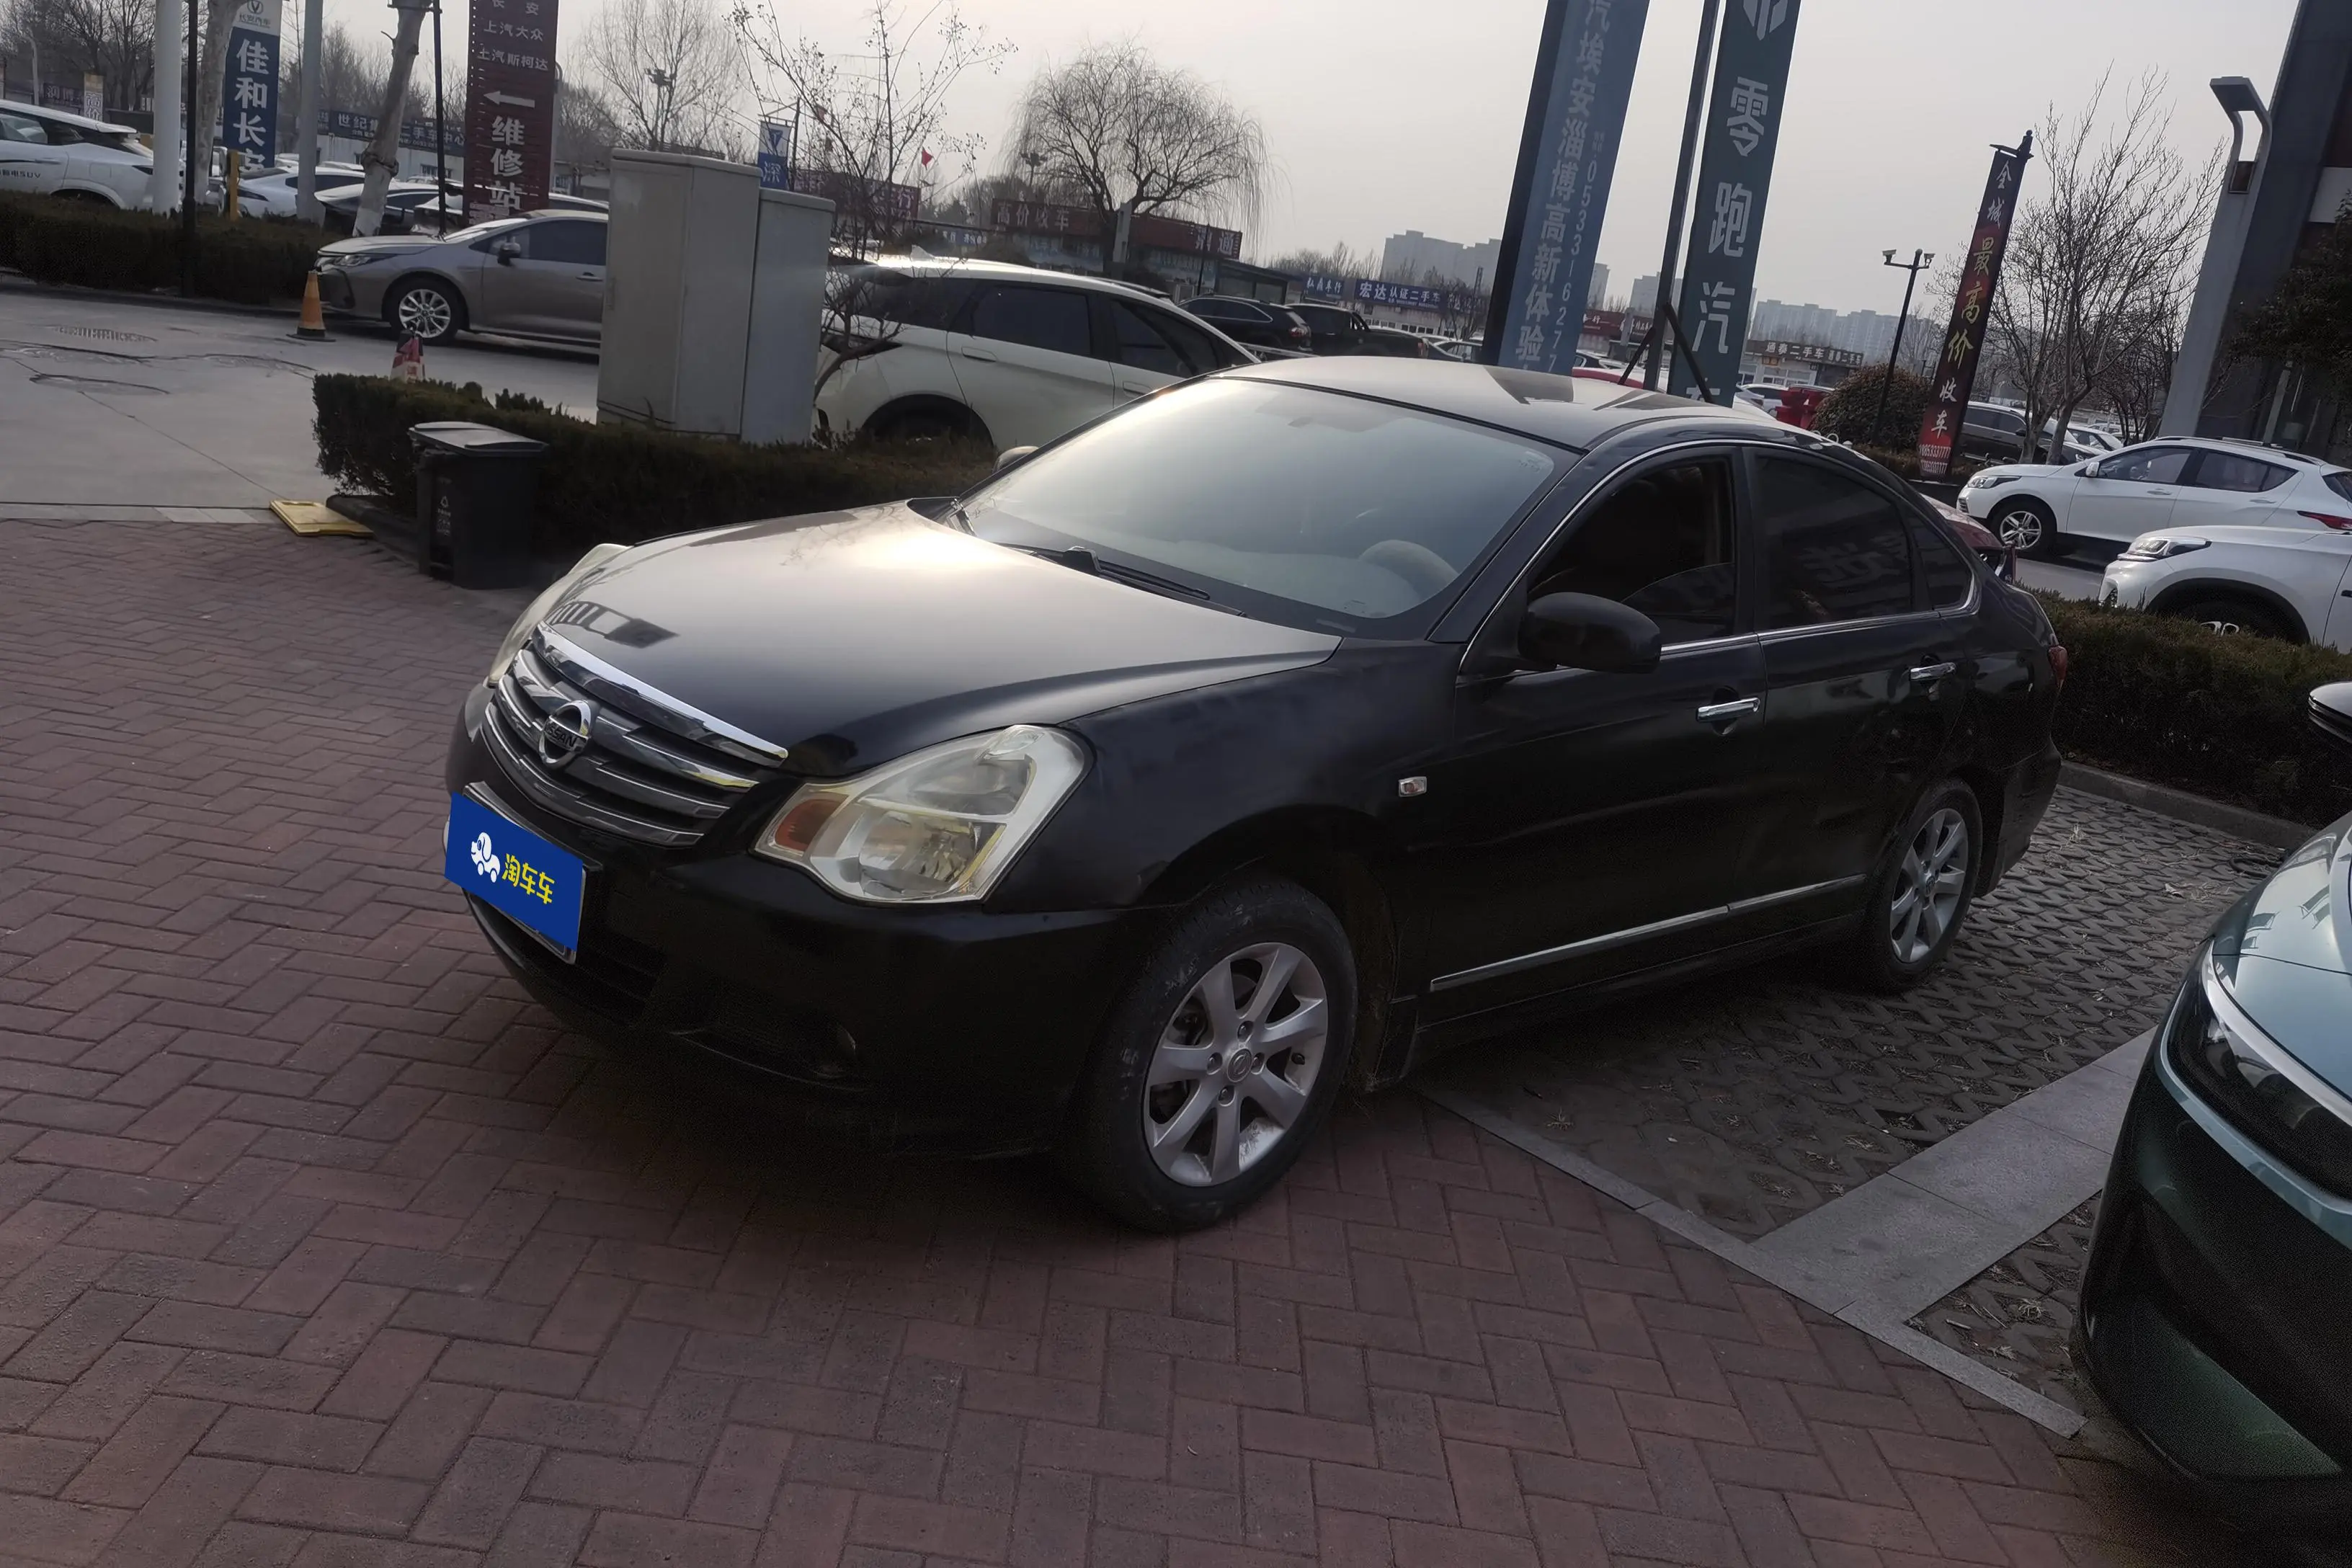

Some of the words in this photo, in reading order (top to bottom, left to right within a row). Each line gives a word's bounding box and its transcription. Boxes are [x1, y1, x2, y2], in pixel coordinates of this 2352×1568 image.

[484, 20, 544, 41] 上汽大众
[477, 47, 549, 71] 上汽斯柯达
[491, 115, 525, 210] 维修站
[1765, 342, 1825, 360] 通泰二手车
[544, 723, 578, 748] SSAN
